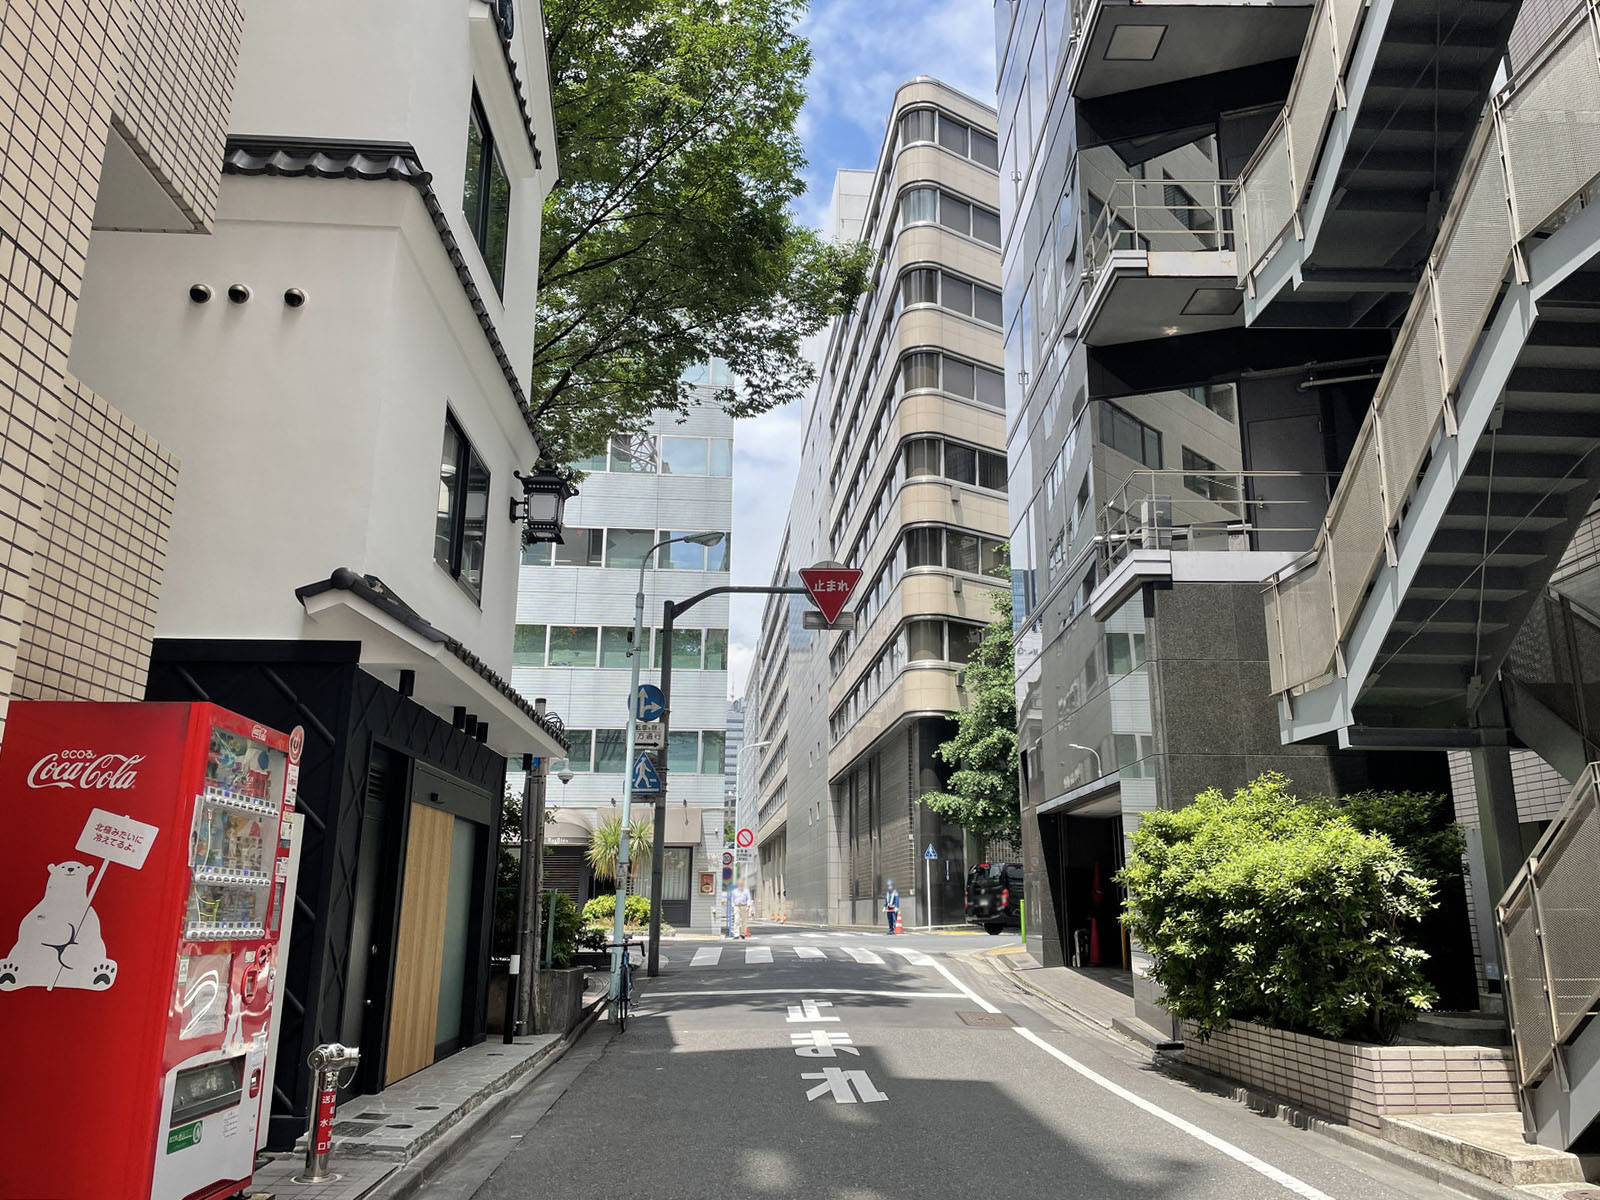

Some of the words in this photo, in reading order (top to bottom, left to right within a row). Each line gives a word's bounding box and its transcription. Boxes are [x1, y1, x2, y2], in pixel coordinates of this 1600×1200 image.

[813, 579, 849, 592] 止まれ
[27, 753, 146, 789] Coca-Cola
[92, 834, 136, 853] 冷えてるよ。
[94, 823, 144, 845] 北極みたいに
[785, 999, 889, 1103] 止まれ
[317, 1095, 331, 1151] 送水口
